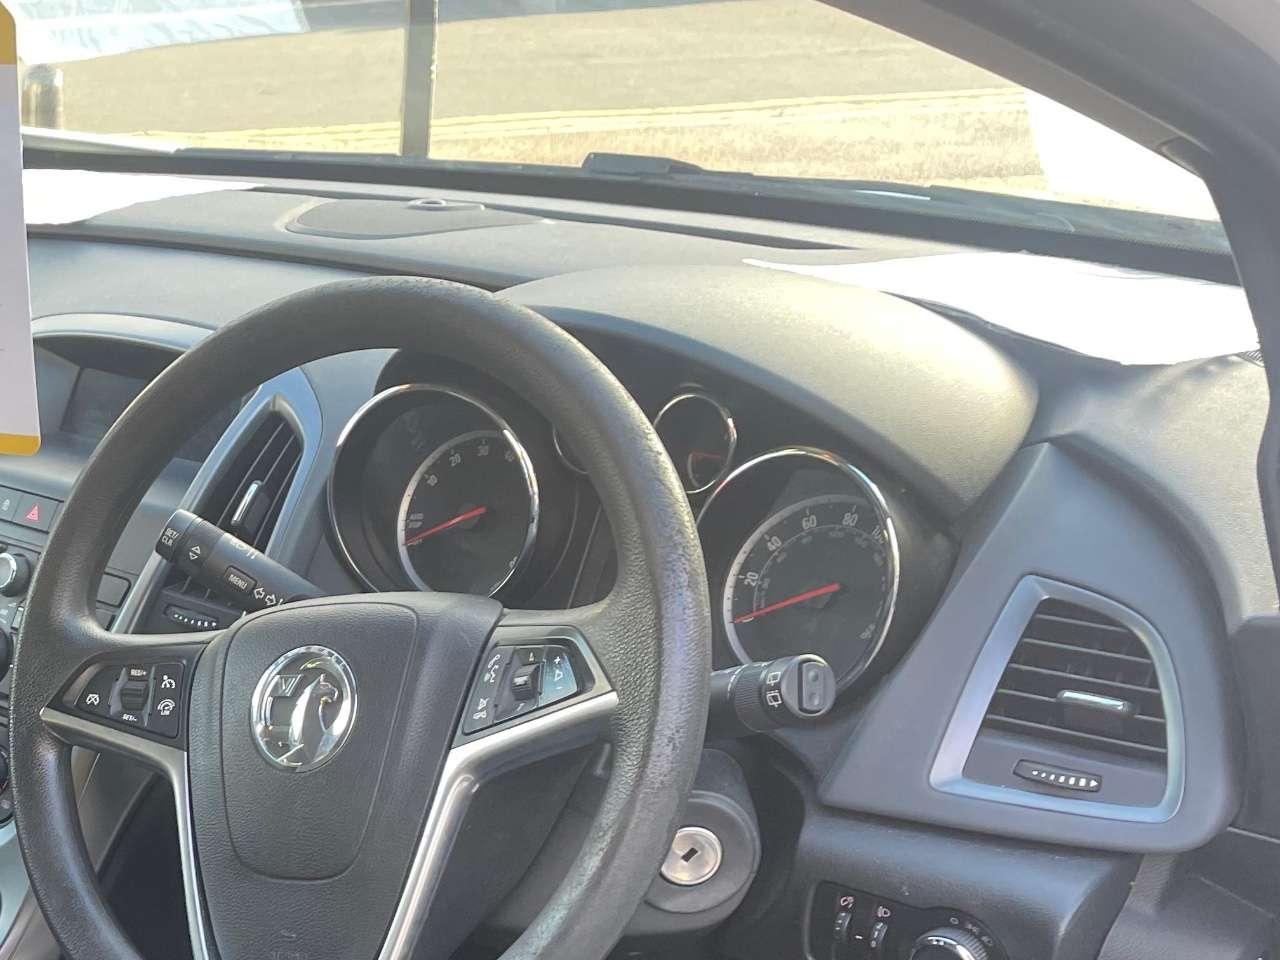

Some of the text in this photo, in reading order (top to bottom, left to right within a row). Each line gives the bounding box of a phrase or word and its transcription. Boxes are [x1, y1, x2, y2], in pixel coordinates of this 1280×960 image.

[802, 514, 818, 530] 60
[841, 512, 859, 527] 80
[227, 573, 249, 590] MENU
[744, 571, 760, 587] 20
